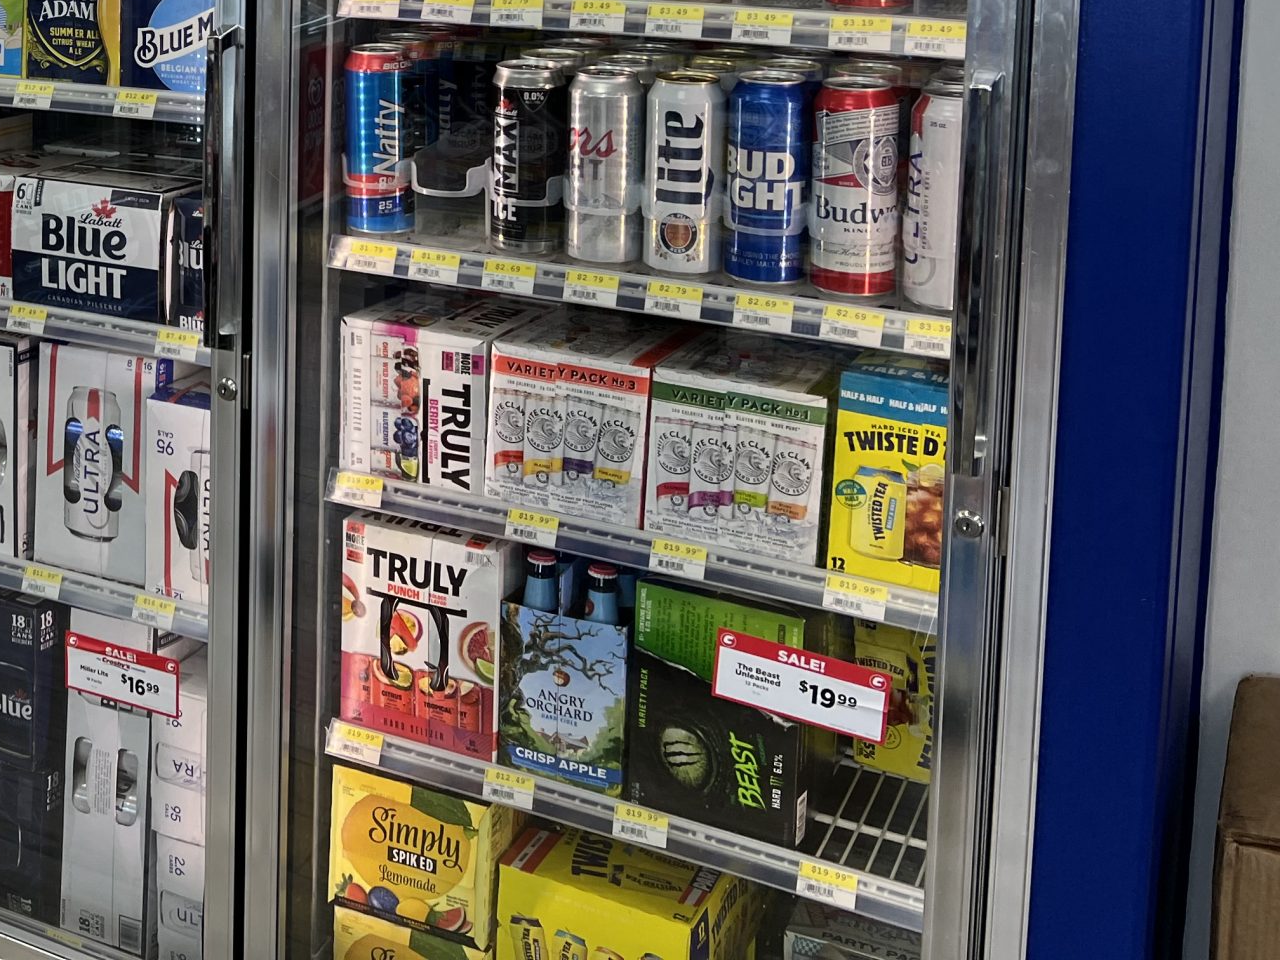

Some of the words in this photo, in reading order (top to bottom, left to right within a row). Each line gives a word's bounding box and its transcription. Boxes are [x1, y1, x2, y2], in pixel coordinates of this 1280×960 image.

[52, 38, 73, 46] CITRUS
[76, 40, 95, 48] WHEAT
[161, 64, 198, 74] BELGIAN
[373, 99, 407, 177] Natty
[17, 183, 26, 200] 6
[78, 213, 122, 228] Labatt
[493, 198, 517, 221] ICE
[42, 213, 127, 261] Blue
[42, 258, 127, 299] LIGHT
[495, 263, 521, 272] $2.69
[48, 294, 83, 307] CANADIAN
[87, 300, 123, 312] PILSENER
[747, 298, 777, 309] $2.69
[836, 308, 866, 321] $2.69
[459, 353, 471, 376] MORE
[429, 398, 439, 433] BERRY
[672, 389, 736, 410] VARIETY
[742, 398, 782, 415] PACK
[785, 406, 810, 421] No.1
[440, 382, 471, 490] TRULY
[844, 432, 938, 456] TWISTED
[898, 427, 919, 435] ICED
[925, 429, 941, 438] TEA
[83, 428, 100, 515] ULTRA
[663, 542, 697, 555] $19.99
[366, 548, 468, 596] TRULY
[831, 557, 845, 570] 12
[387, 583, 420, 600] PUNCH
[105, 647, 136, 663] SALE!
[777, 649, 826, 673] SALE!
[735, 669, 781, 688] Unleashed
[737, 662, 751, 672] The
[752, 666, 781, 680] Beast
[526, 697, 592, 722] ORCHARD
[538, 688, 586, 708] ANGRY
[515, 746, 556, 764] CRISP
[559, 759, 607, 780] APPLE
[728, 731, 766, 810] BEAST
[368, 806, 463, 872] Simply
[392, 848, 434, 872] SPIKED
[379, 864, 436, 894] Lemonade
